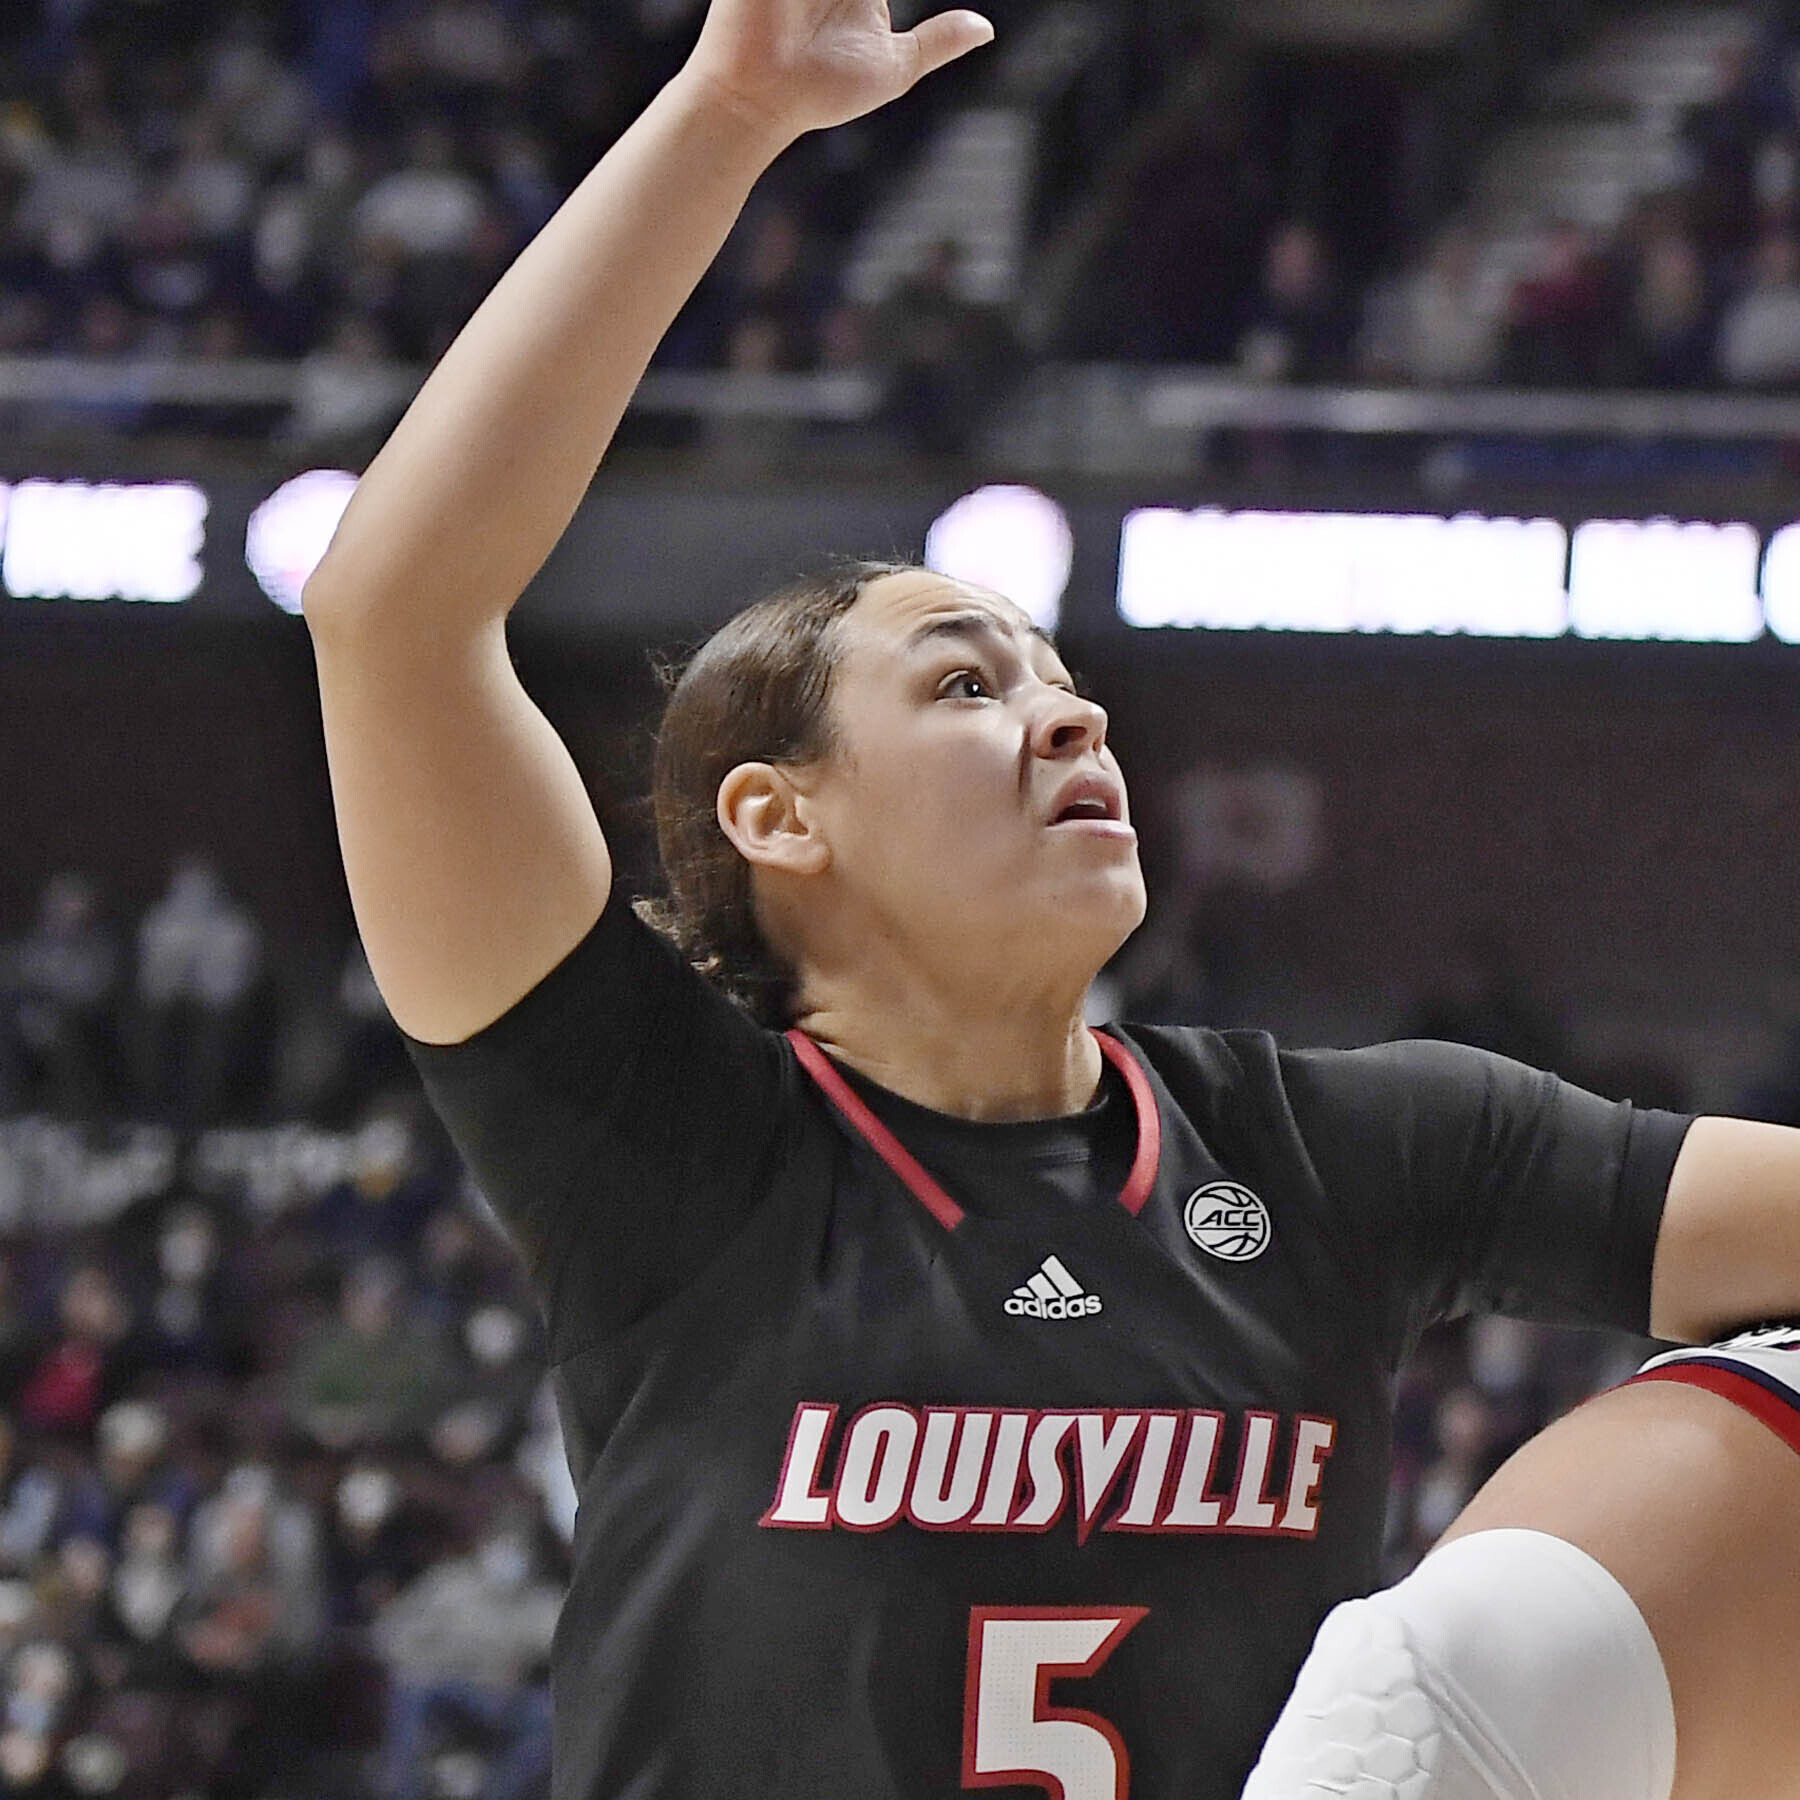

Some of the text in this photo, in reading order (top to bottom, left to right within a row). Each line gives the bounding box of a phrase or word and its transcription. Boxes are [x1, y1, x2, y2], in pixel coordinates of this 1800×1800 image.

[1198, 1209, 1262, 1227] ACC
[1003, 1294, 1103, 1320] adidas
[758, 1402, 1338, 1546] LOUISVILLE
[960, 1605, 1151, 1800] 5
